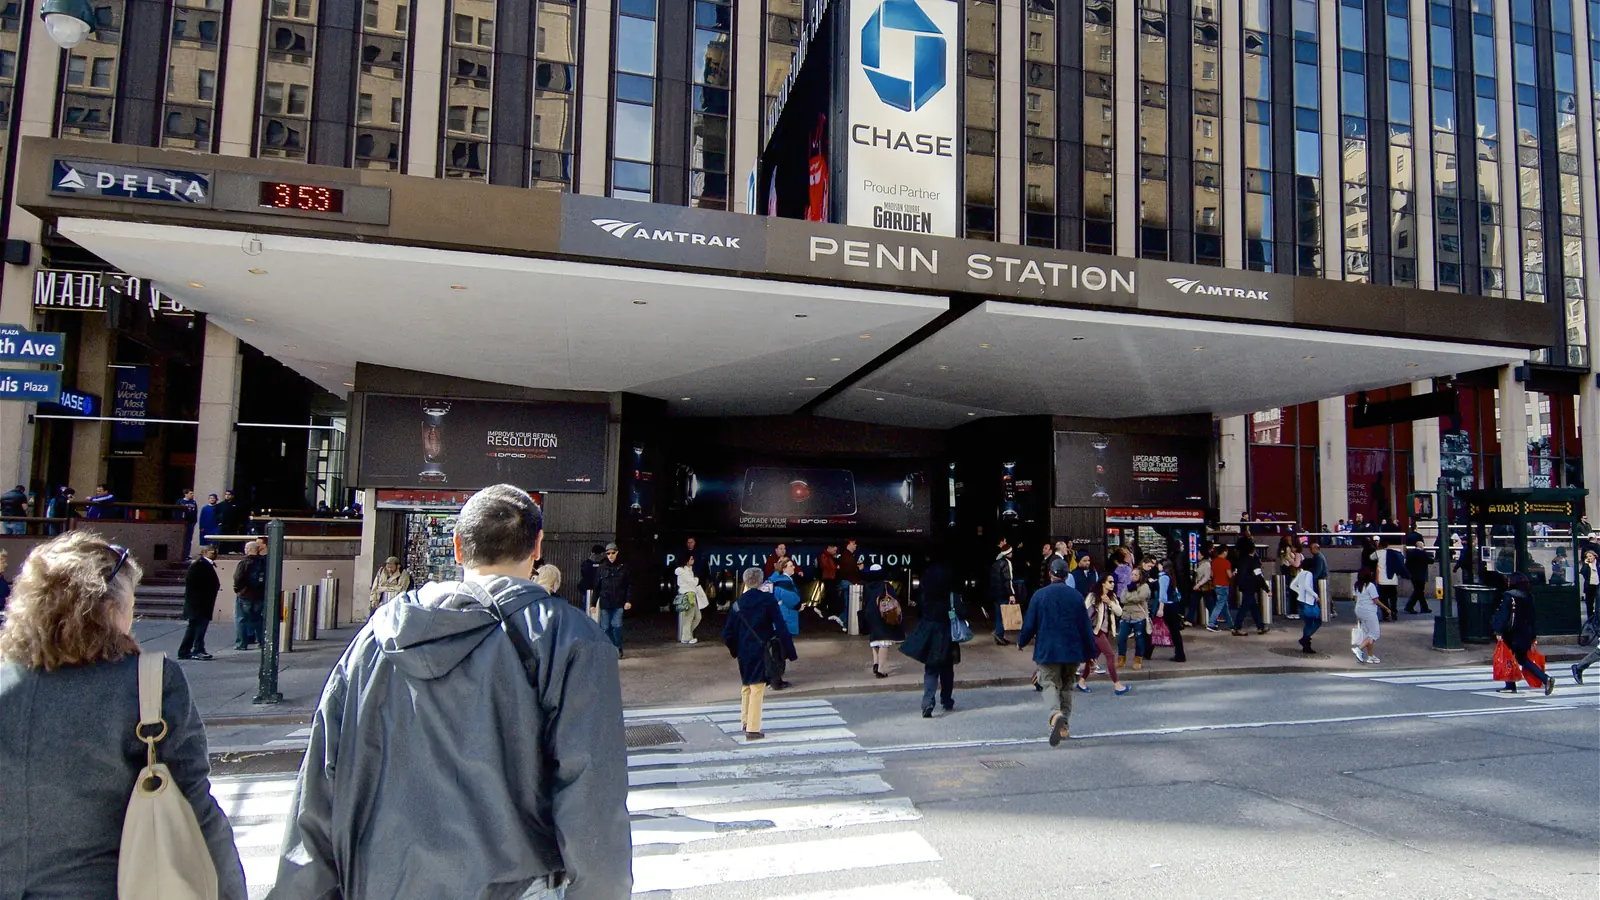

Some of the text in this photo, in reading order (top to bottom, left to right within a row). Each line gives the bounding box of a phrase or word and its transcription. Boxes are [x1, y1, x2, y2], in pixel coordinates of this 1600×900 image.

[852, 123, 953, 157] CHASE
[96, 171, 204, 198] DELTA
[863, 179, 941, 200] Proud Partner
[883, 201, 920, 214] MADISON SQUARE
[873, 205, 932, 234] GARDEN
[633, 227, 741, 249] AMTRAK
[809, 235, 1136, 294] PENN STATION
[1194, 284, 1269, 301] AMTRAK
[20, 339, 56, 356] Ave
[23, 381, 49, 392] Plaza
[120, 381, 136, 391] The
[61, 391, 84, 411] HASE
[117, 390, 148, 400] World's
[123, 400, 144, 408] Most
[115, 407, 146, 417] Famous
[487, 436, 557, 447] RESOLUTION
[1348, 490, 1368, 498] RETAIL
[1496, 504, 1514, 513] TAXI
[769, 517, 787, 525] YOUR
